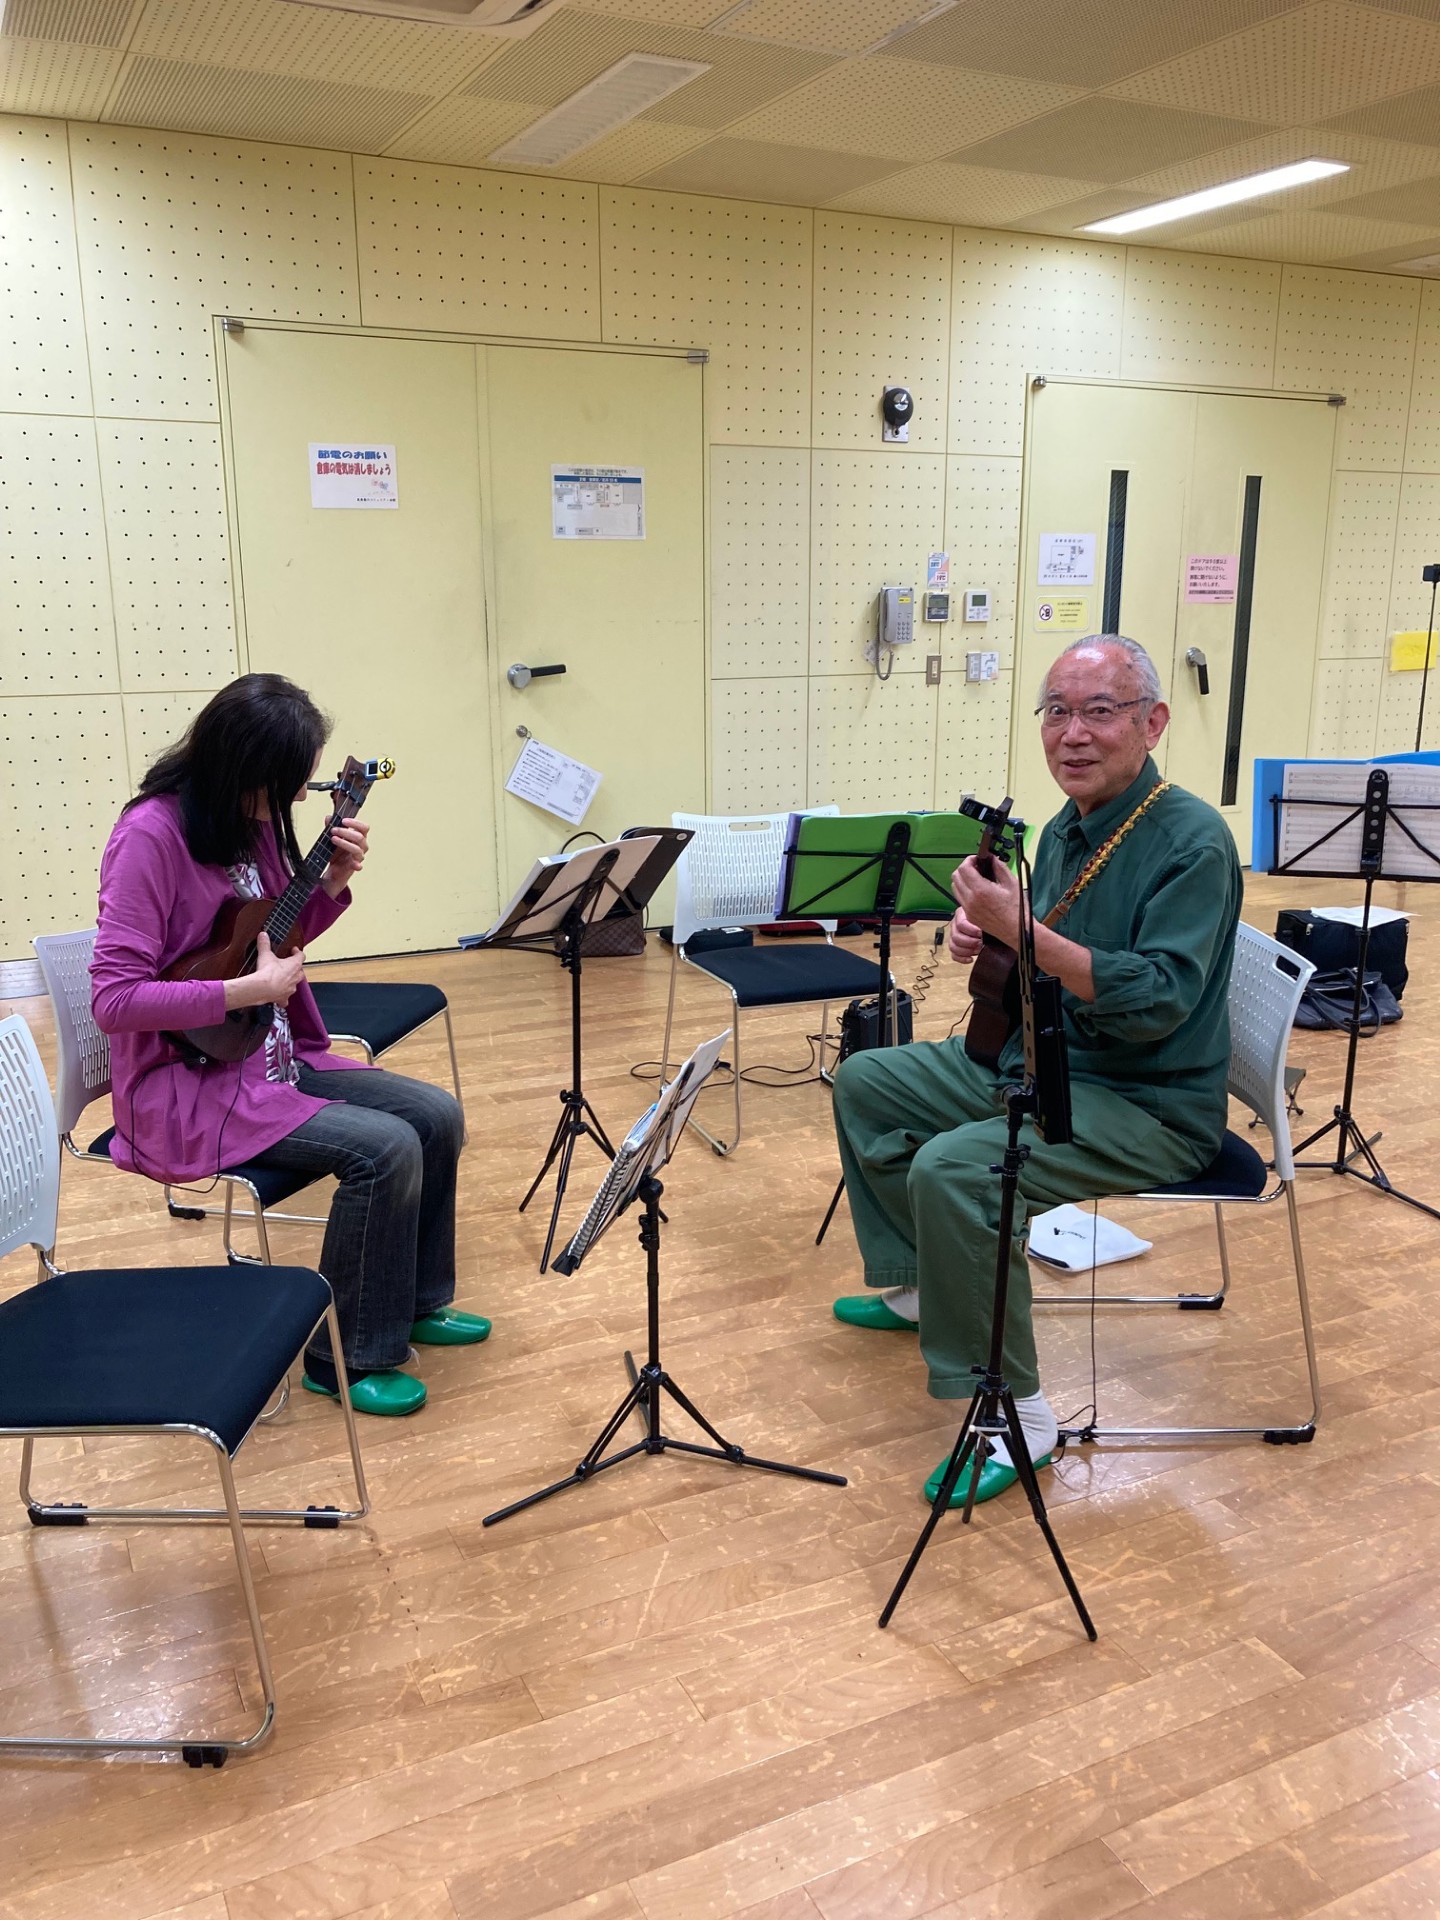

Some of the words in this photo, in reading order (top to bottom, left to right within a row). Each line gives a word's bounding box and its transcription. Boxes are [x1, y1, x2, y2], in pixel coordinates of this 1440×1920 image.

[317, 449, 388, 460] 節電のお願い
[316, 461, 392, 476] 倉庫の電気は消しましょう
